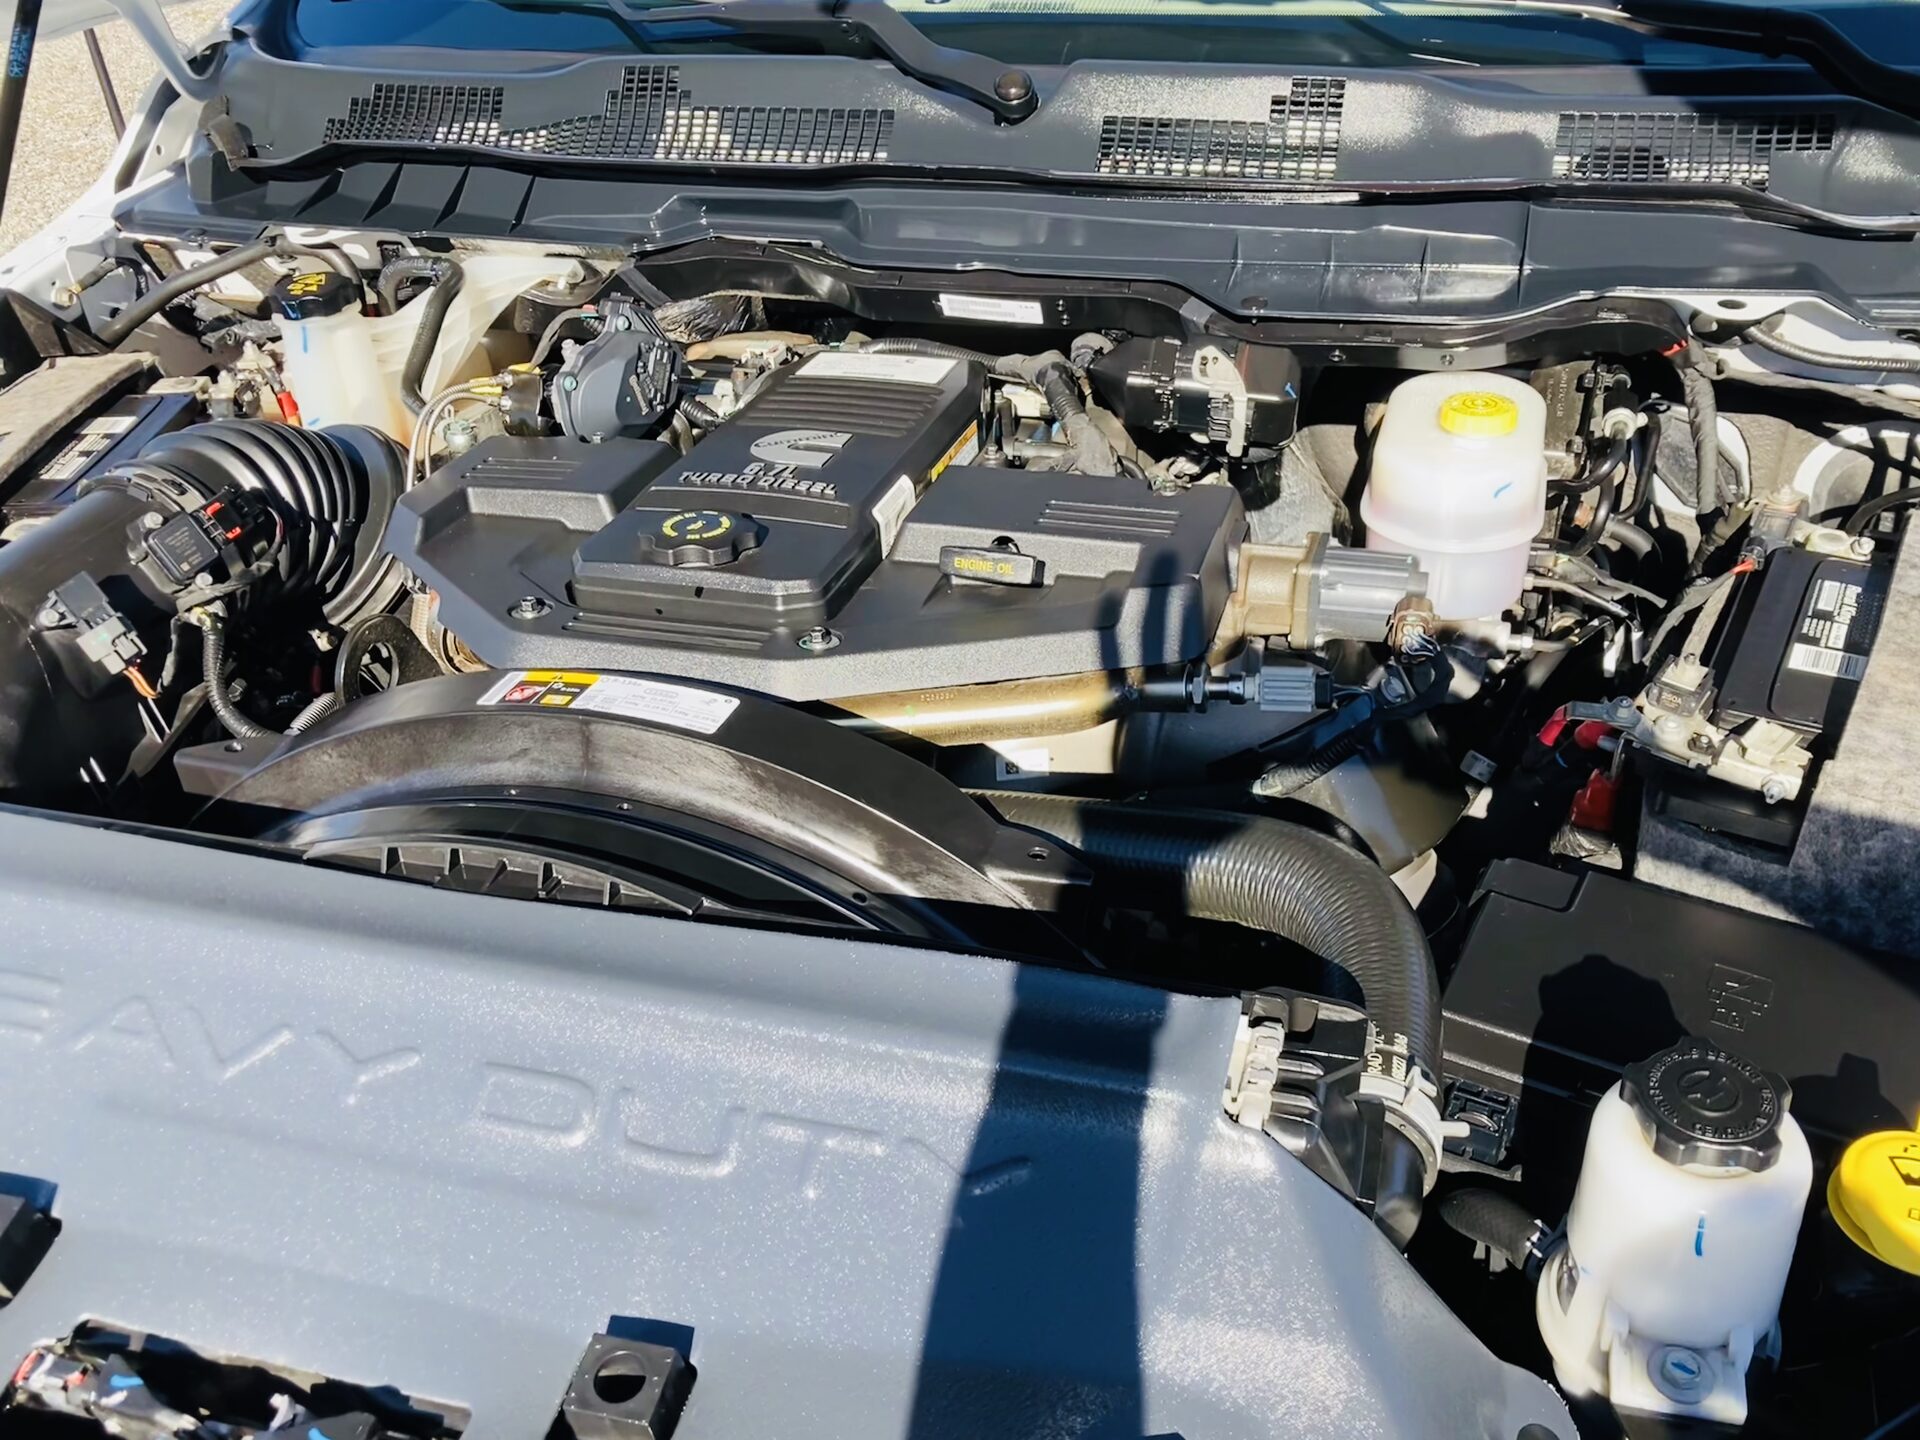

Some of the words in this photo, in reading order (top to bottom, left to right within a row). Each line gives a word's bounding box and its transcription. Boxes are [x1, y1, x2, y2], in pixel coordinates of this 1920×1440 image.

[742, 462, 799, 479] 6.7L
[678, 471, 755, 487] TURBO
[757, 476, 838, 496] DIESEL
[954, 557, 993, 572] ENGINE
[997, 562, 1015, 575] OIL
[478, 1061, 1034, 1230] DUTY
